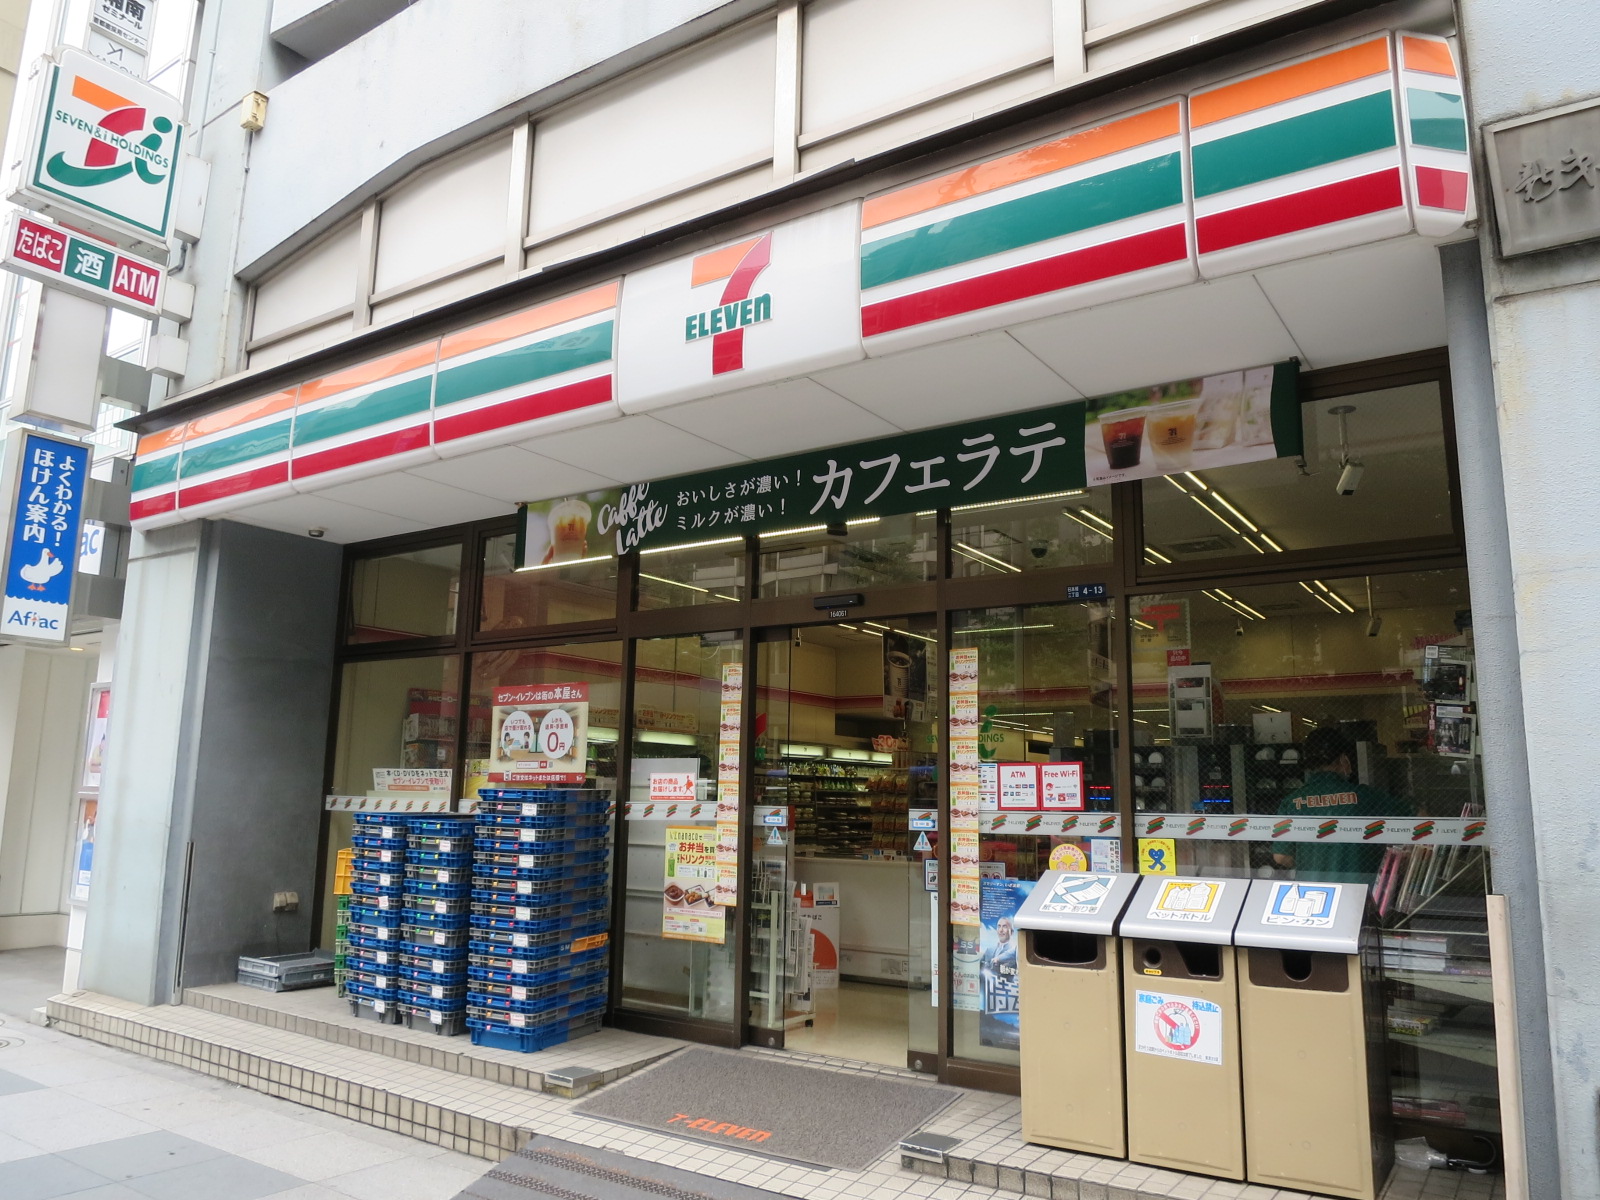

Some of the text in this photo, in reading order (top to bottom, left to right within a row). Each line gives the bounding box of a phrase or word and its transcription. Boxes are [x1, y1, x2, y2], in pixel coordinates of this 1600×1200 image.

[102, 4, 143, 30] ゼミナール
[110, 135, 169, 168] HOLDINGS
[17, 226, 63, 265] たばこ
[74, 246, 106, 281] 酒
[116, 264, 157, 299] ATM
[810, 421, 1066, 516] カフェラテ
[23, 448, 55, 544] ほけん案内
[676, 469, 802, 507] おいしさが濃い！
[616, 499, 669, 556] Latte
[676, 498, 786, 531] ミルクが濃い！
[1083, 585, 1103, 595] 4-13
[1044, 769, 1079, 778] Free Wi-Fi
[1042, 903, 1098, 913] 紙くず・割り箸
[1150, 911, 1211, 921] ペットボトル
[1266, 916, 1330, 926] ビン・カン
